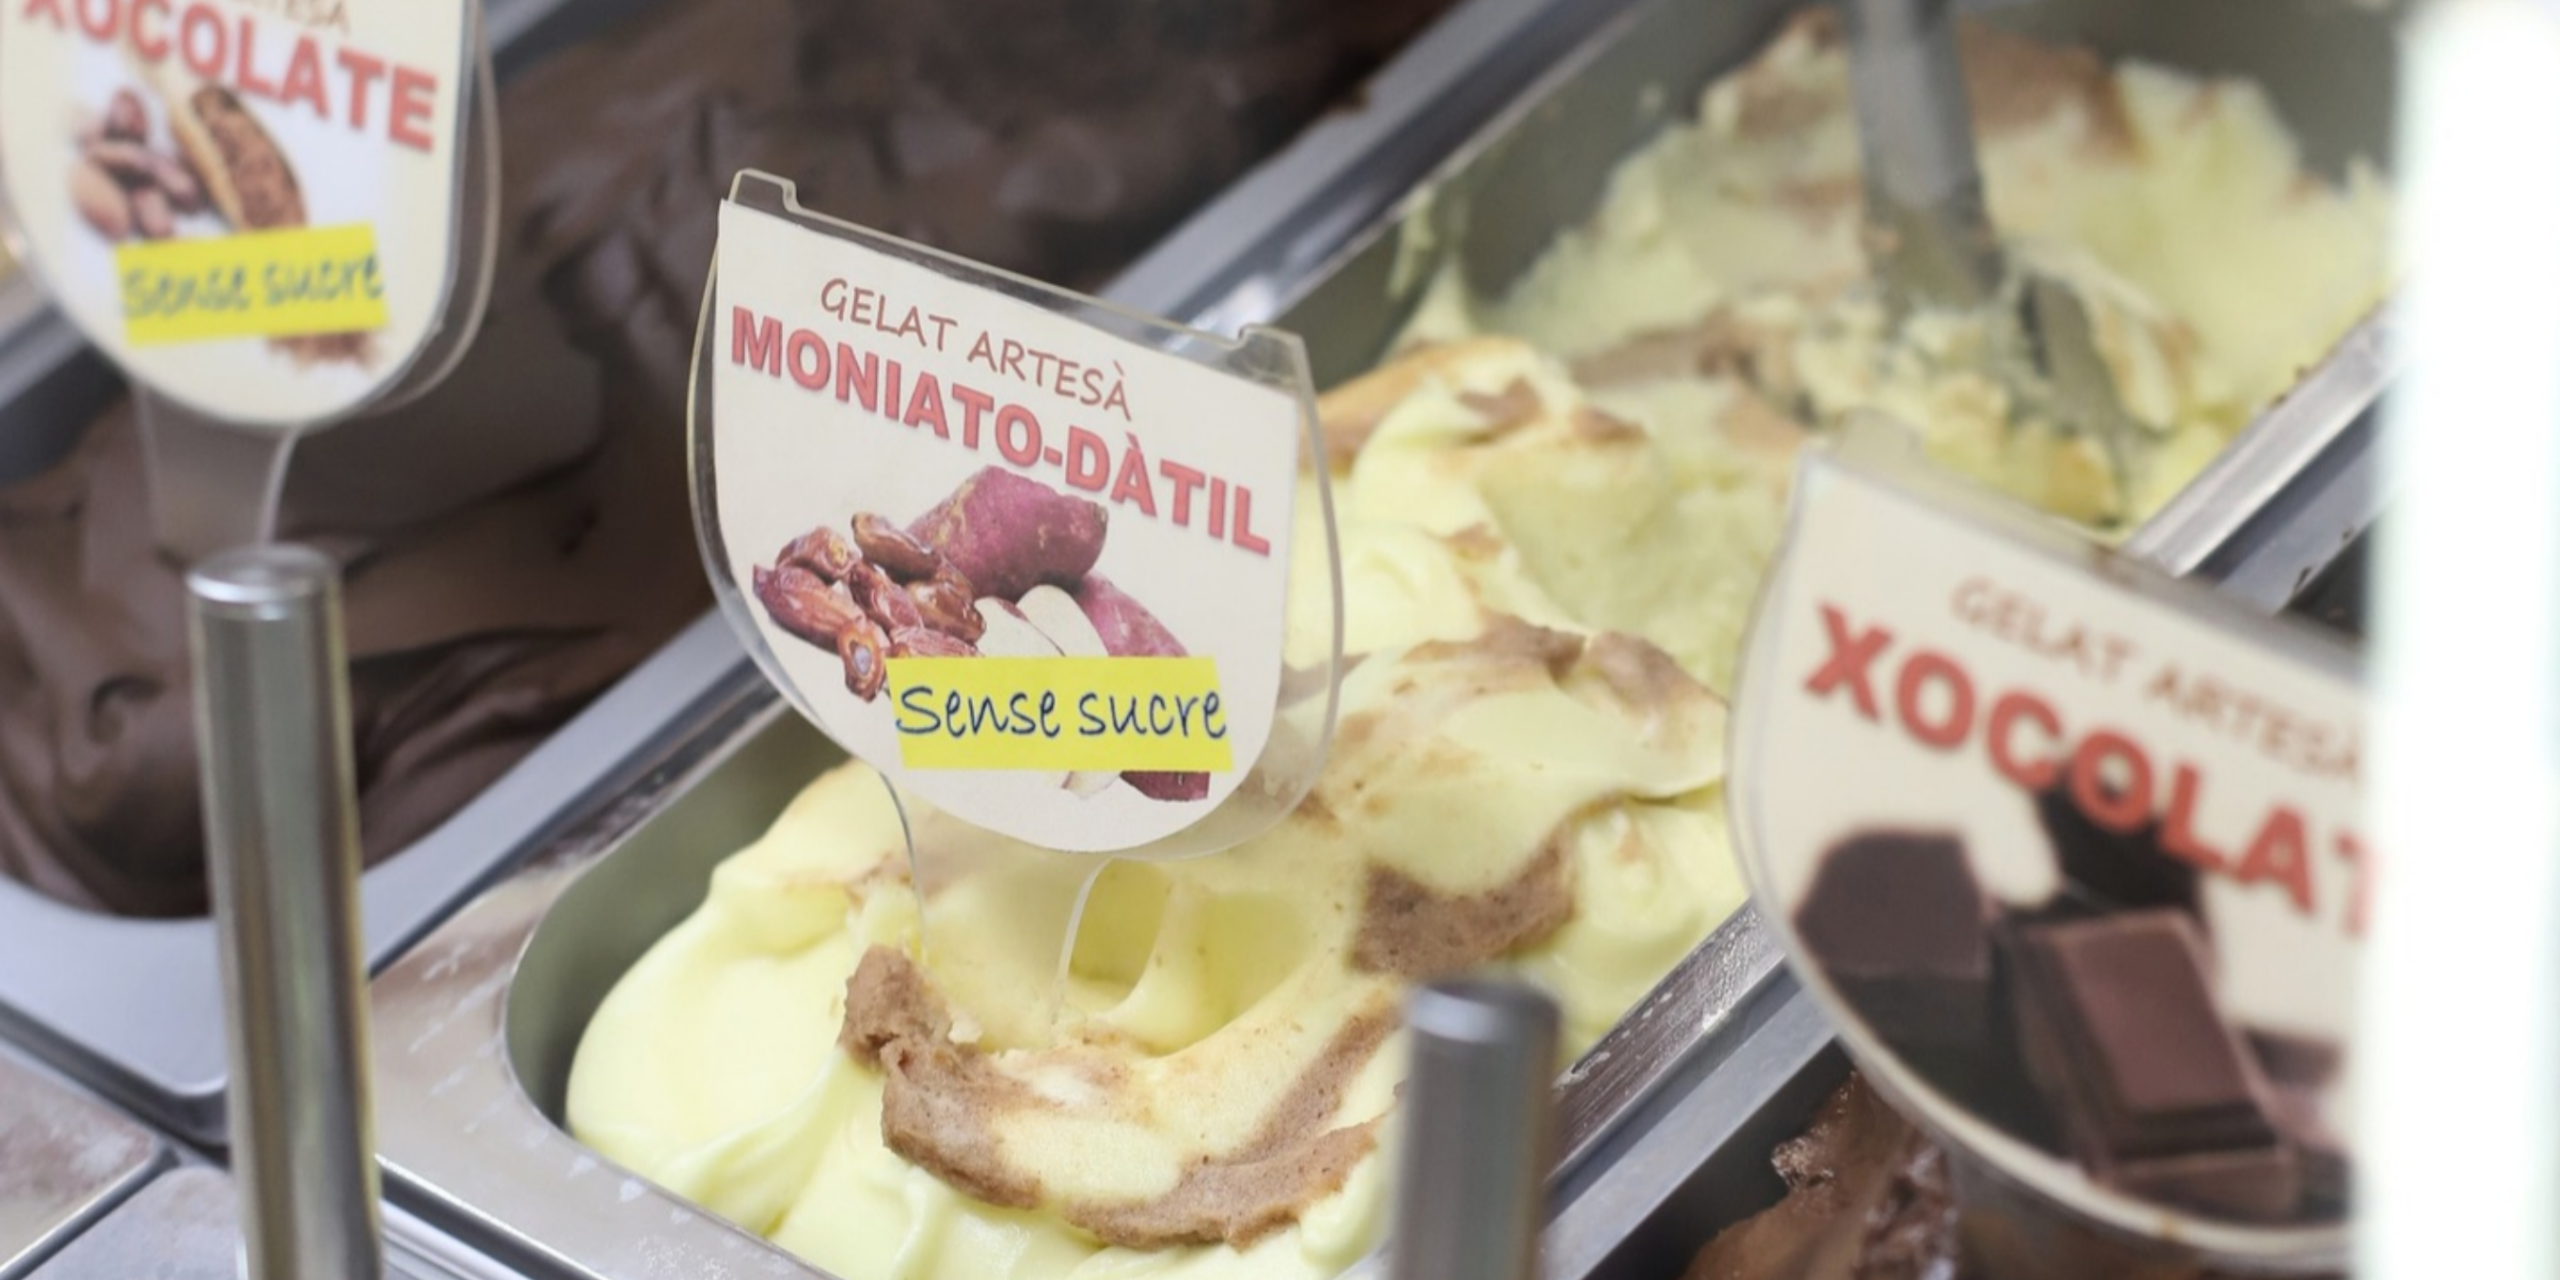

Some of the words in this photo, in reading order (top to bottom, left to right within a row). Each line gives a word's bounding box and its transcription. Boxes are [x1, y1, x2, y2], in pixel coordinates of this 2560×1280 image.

[262, 254, 384, 307] sucre
[820, 278, 958, 352] GELAT
[966, 330, 1133, 422] ARTESÀ
[731, 305, 1272, 558] MONIATO-DÀTIL
[1949, 575, 2138, 684] GELAT
[895, 685, 1061, 739] Sense
[1078, 691, 1227, 740] sucre
